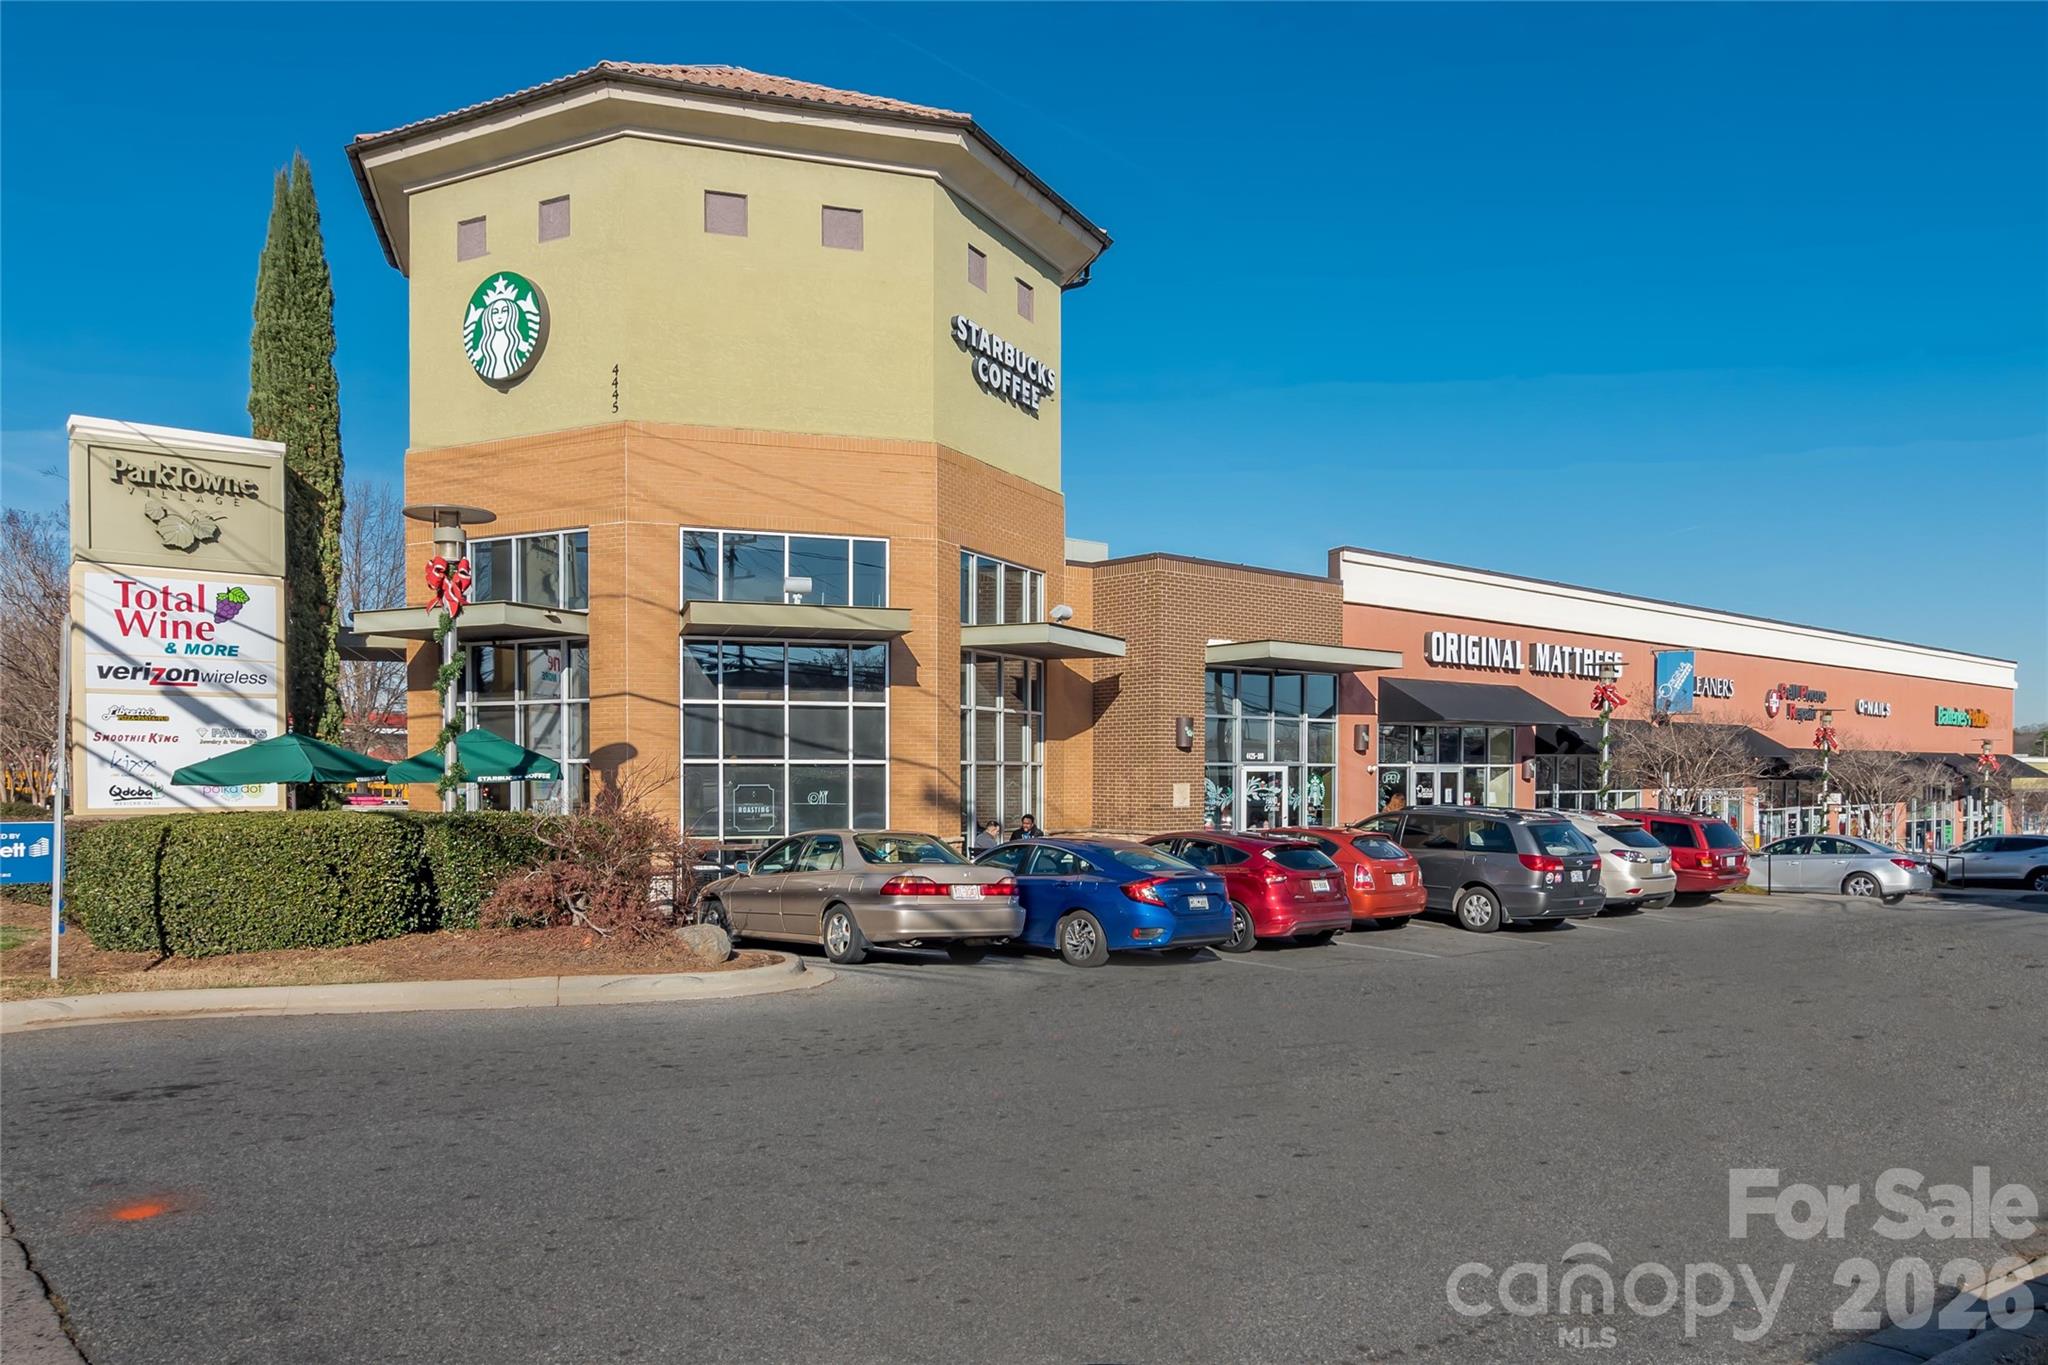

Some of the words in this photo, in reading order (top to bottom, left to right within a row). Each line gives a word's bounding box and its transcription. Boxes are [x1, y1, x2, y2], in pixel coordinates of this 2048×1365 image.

[954, 315, 1056, 392] STARBUCKS
[611, 363, 619, 414] 4445
[975, 357, 1040, 410] COFFEE
[127, 487, 240, 507] VILLAGE
[113, 580, 205, 612] Total
[114, 609, 215, 641] Wine
[164, 642, 177, 654] &
[184, 643, 239, 657] MORE
[1430, 631, 1525, 670] ORIGINAL
[1693, 675, 1735, 697] EANERS
[109, 784, 154, 800] Qdoba
